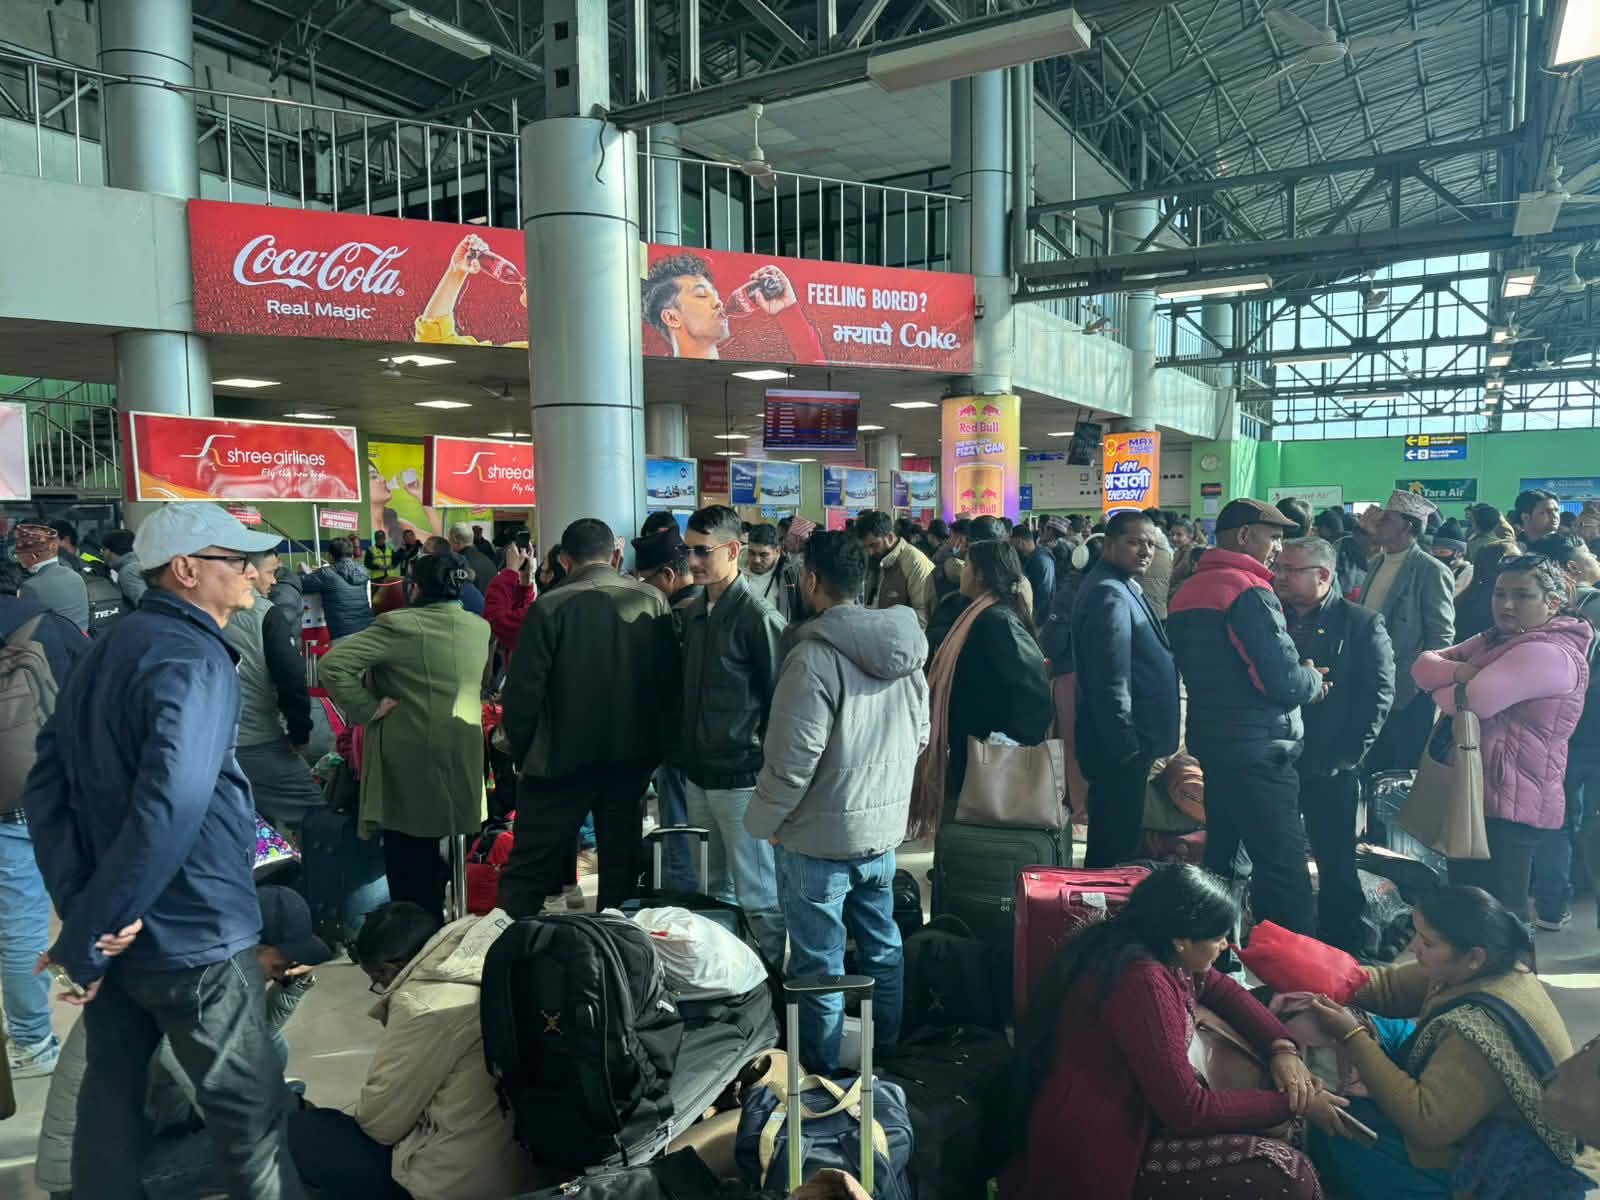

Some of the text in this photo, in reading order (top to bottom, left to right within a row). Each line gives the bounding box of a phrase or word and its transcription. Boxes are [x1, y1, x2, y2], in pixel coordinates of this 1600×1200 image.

[233, 235, 408, 295] Coca-Cola
[807, 283, 928, 313] FEELING BORED?
[267, 300, 372, 321] Real Magic
[960, 422, 999, 433] Red Bull
[1120, 461, 1139, 472] AM
[1424, 488, 1465, 497] Tara Air
